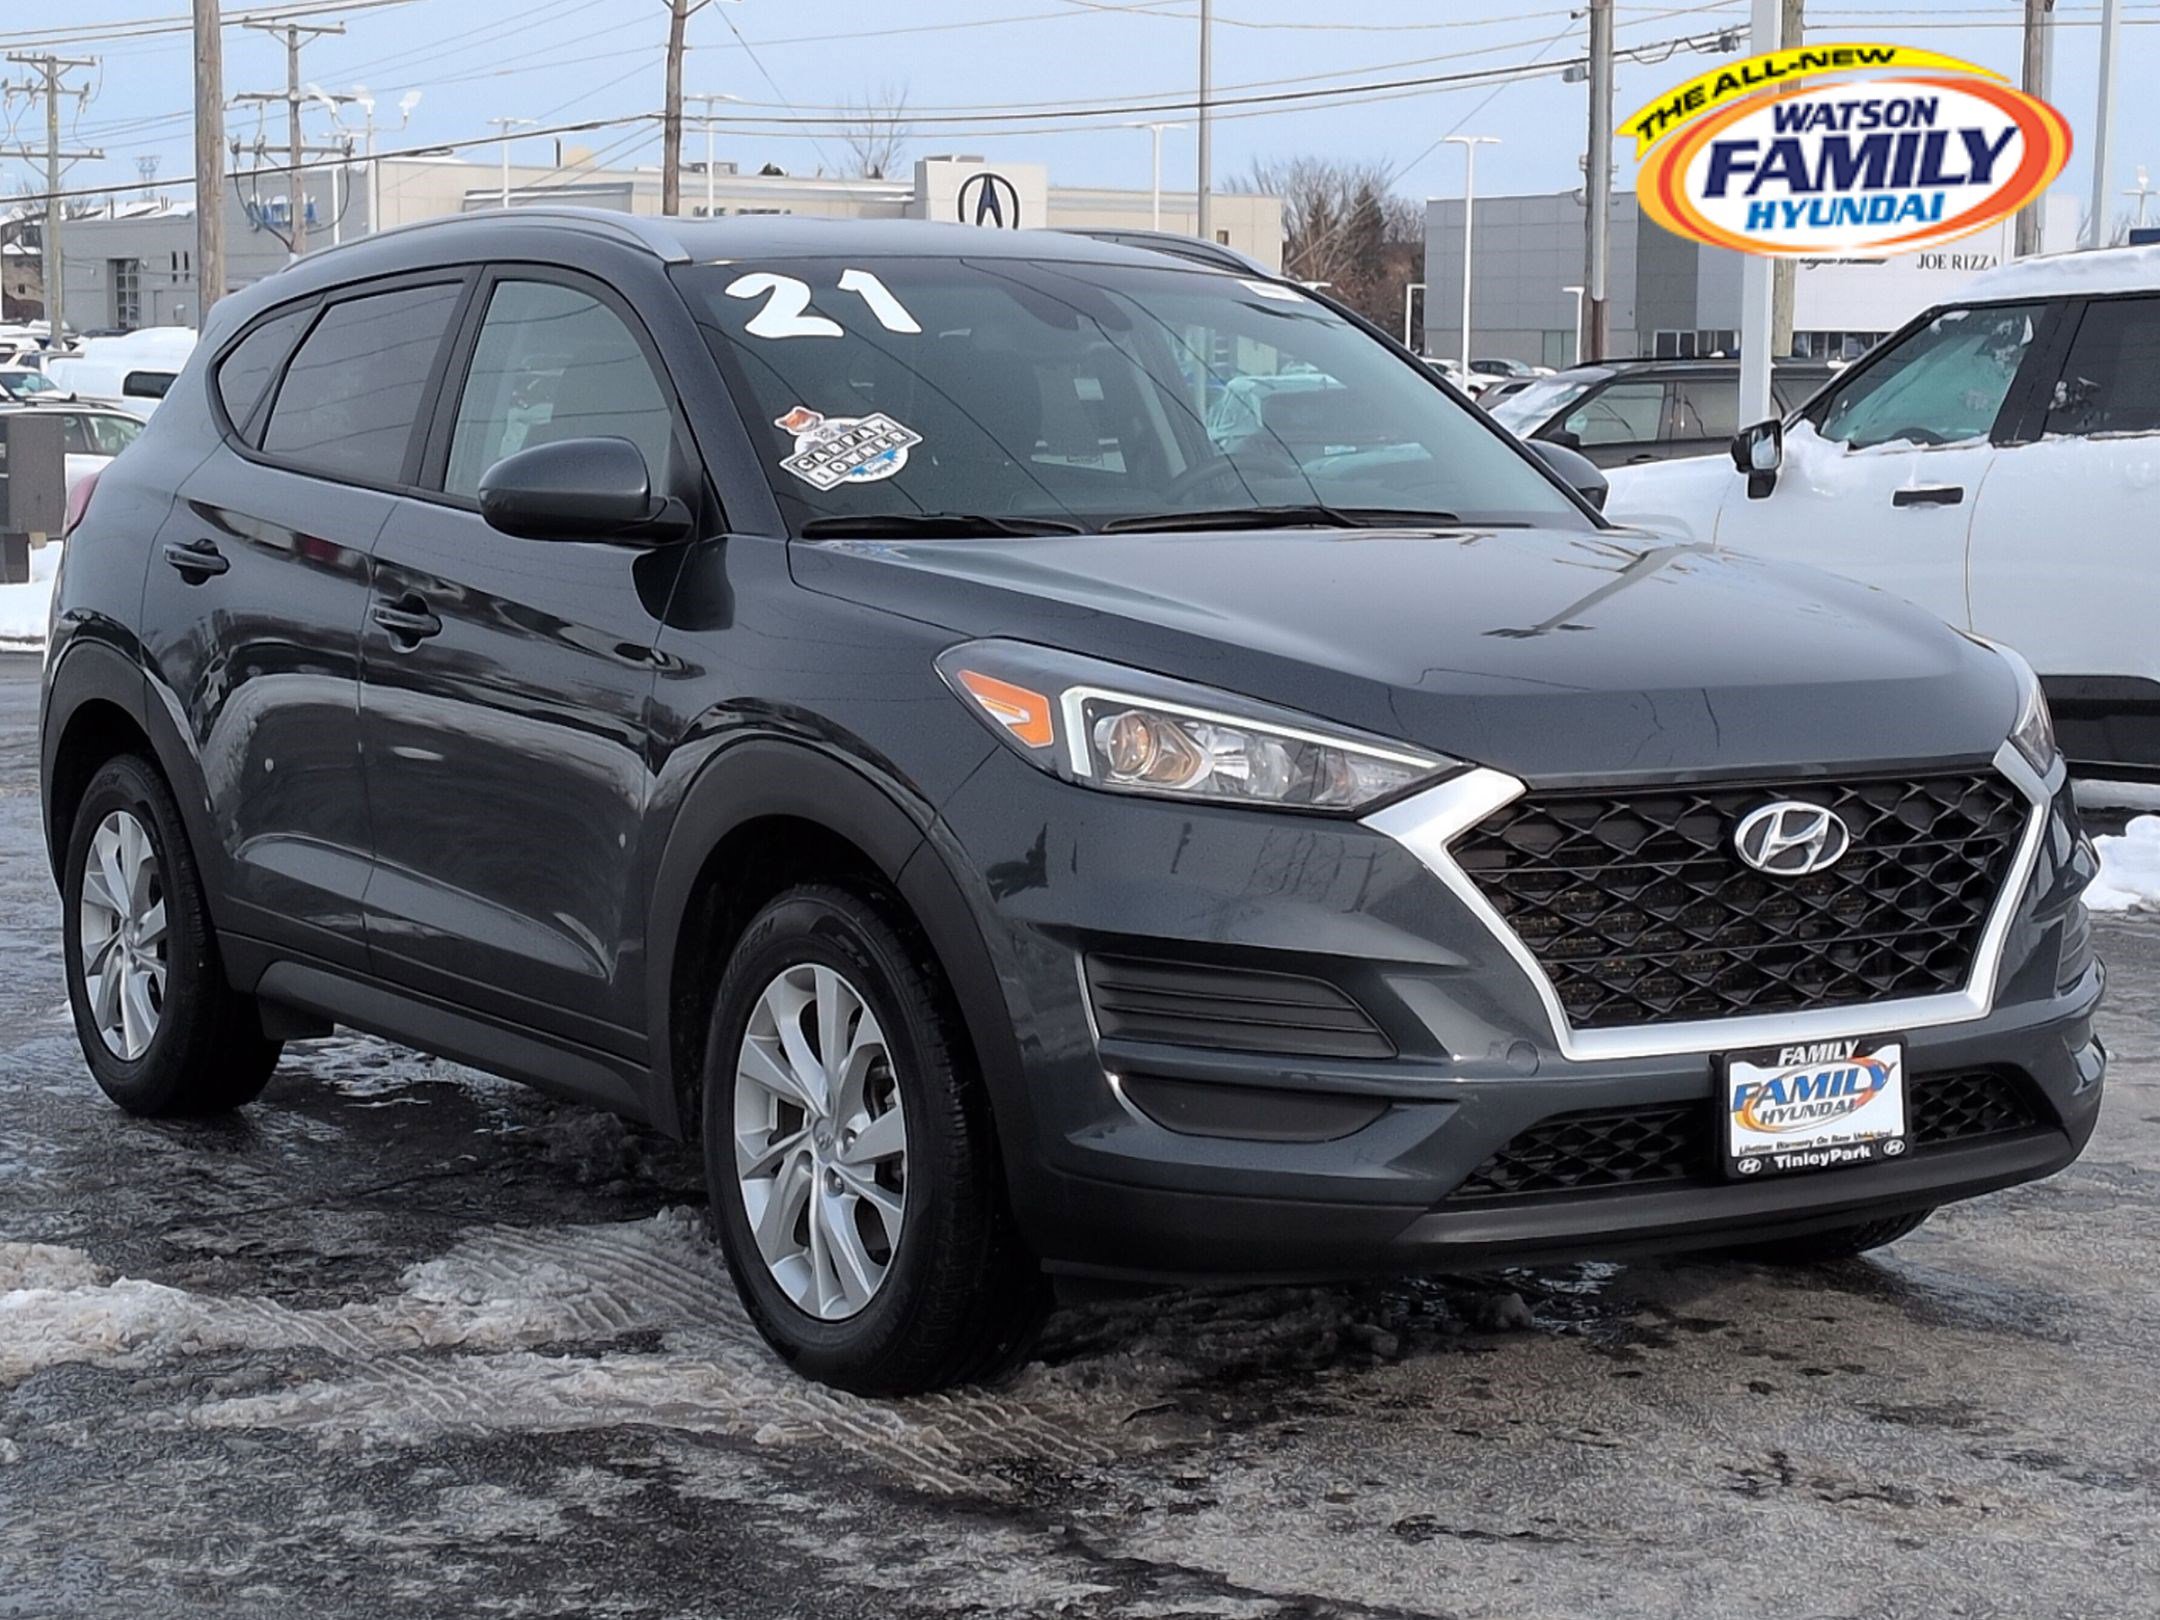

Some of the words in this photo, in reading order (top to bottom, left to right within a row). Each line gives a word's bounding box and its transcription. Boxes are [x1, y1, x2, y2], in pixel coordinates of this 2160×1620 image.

[1916, 254, 1946, 269] JOE
[826, 429, 909, 475] OWNER
[1778, 1040, 1860, 1067] FAMILY
[1732, 1061, 1898, 1112] FAMILY
[1760, 1099, 1857, 1125] HYUNDAI
